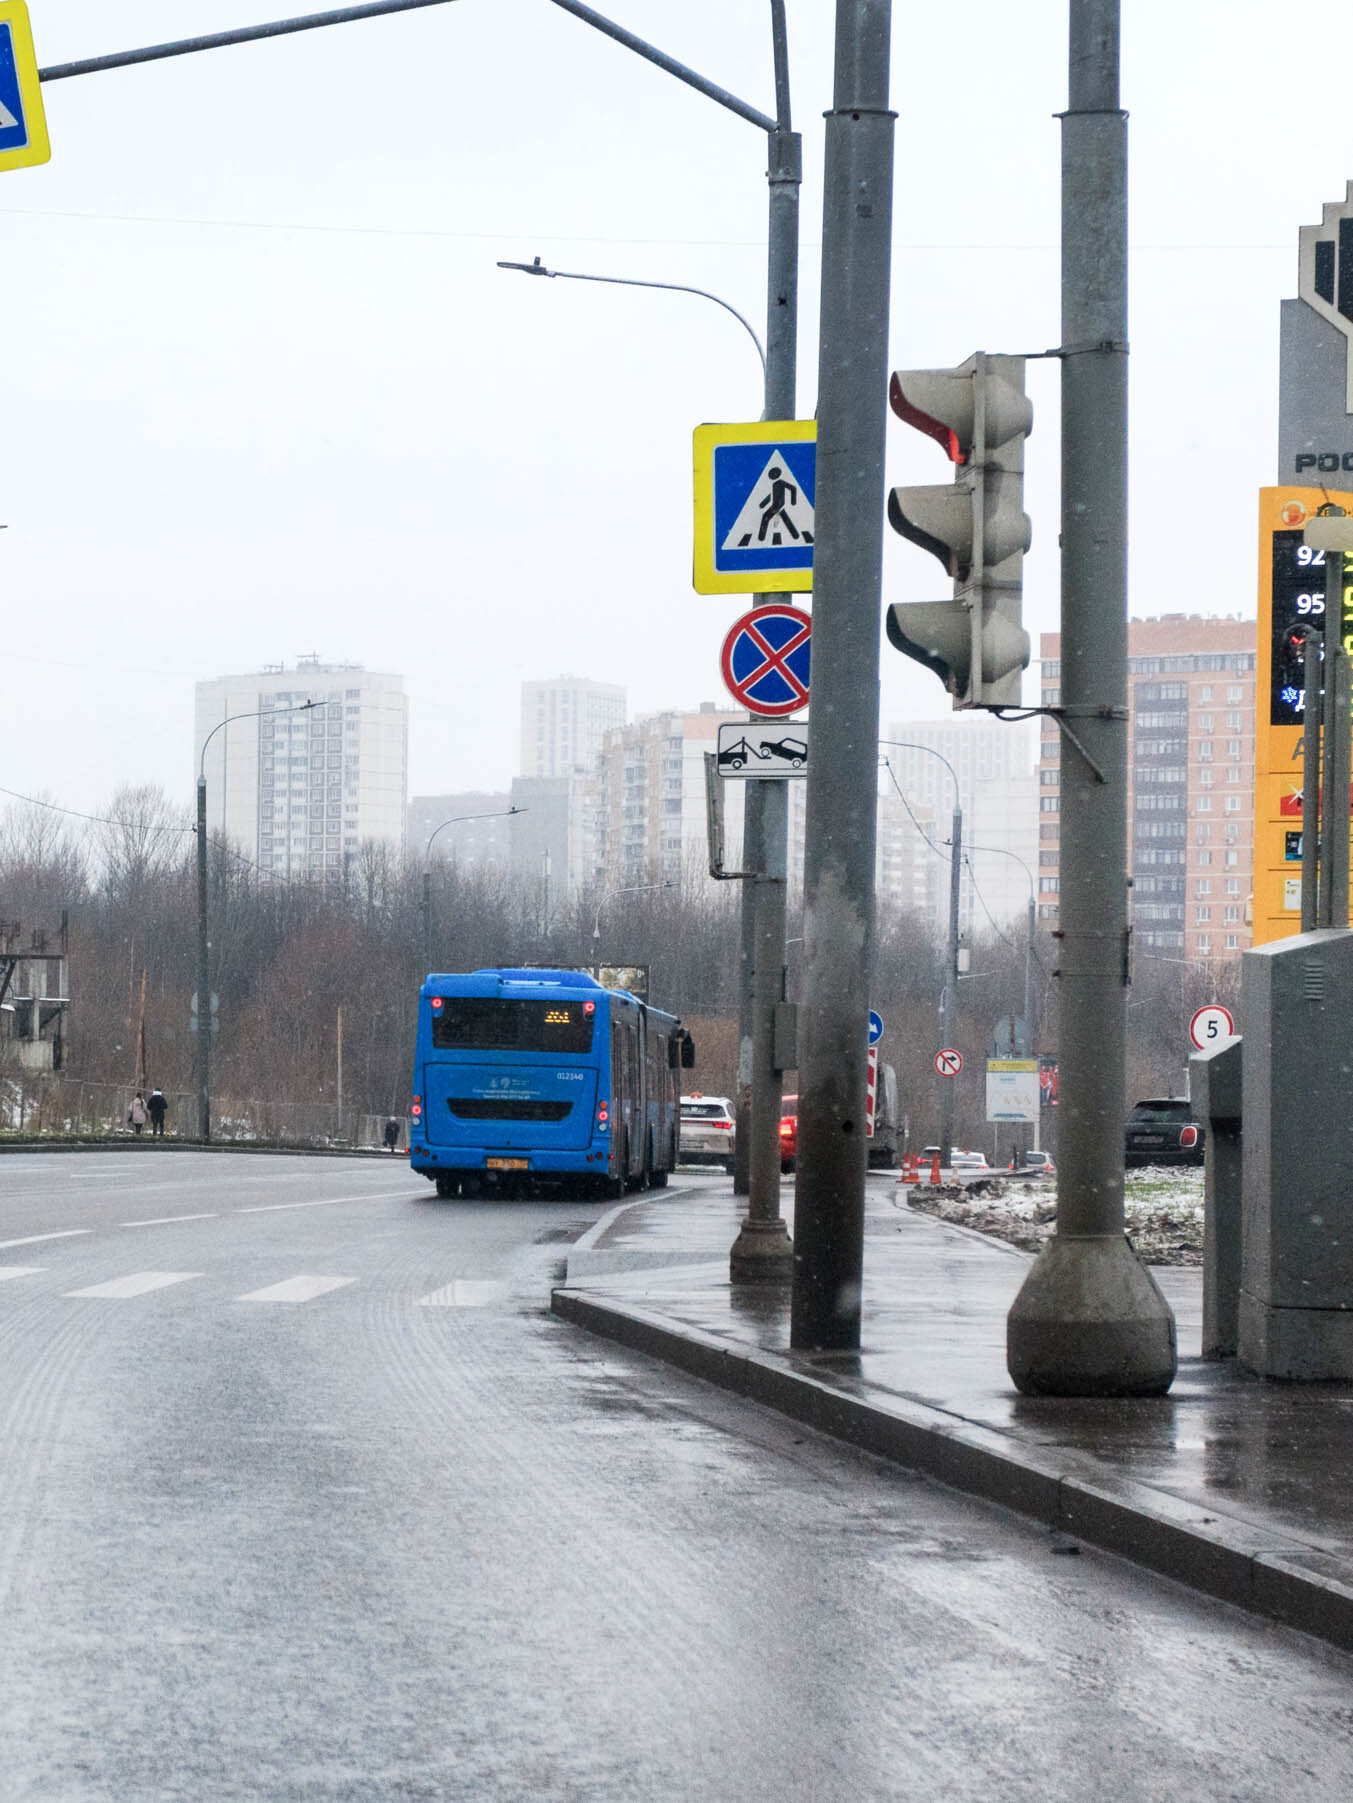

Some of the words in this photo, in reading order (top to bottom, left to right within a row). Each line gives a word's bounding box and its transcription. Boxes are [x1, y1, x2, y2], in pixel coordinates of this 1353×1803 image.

[1297, 545, 1326, 566] 92
[1296, 593, 1326, 615] 95
[1207, 1020, 1218, 1039] 5
